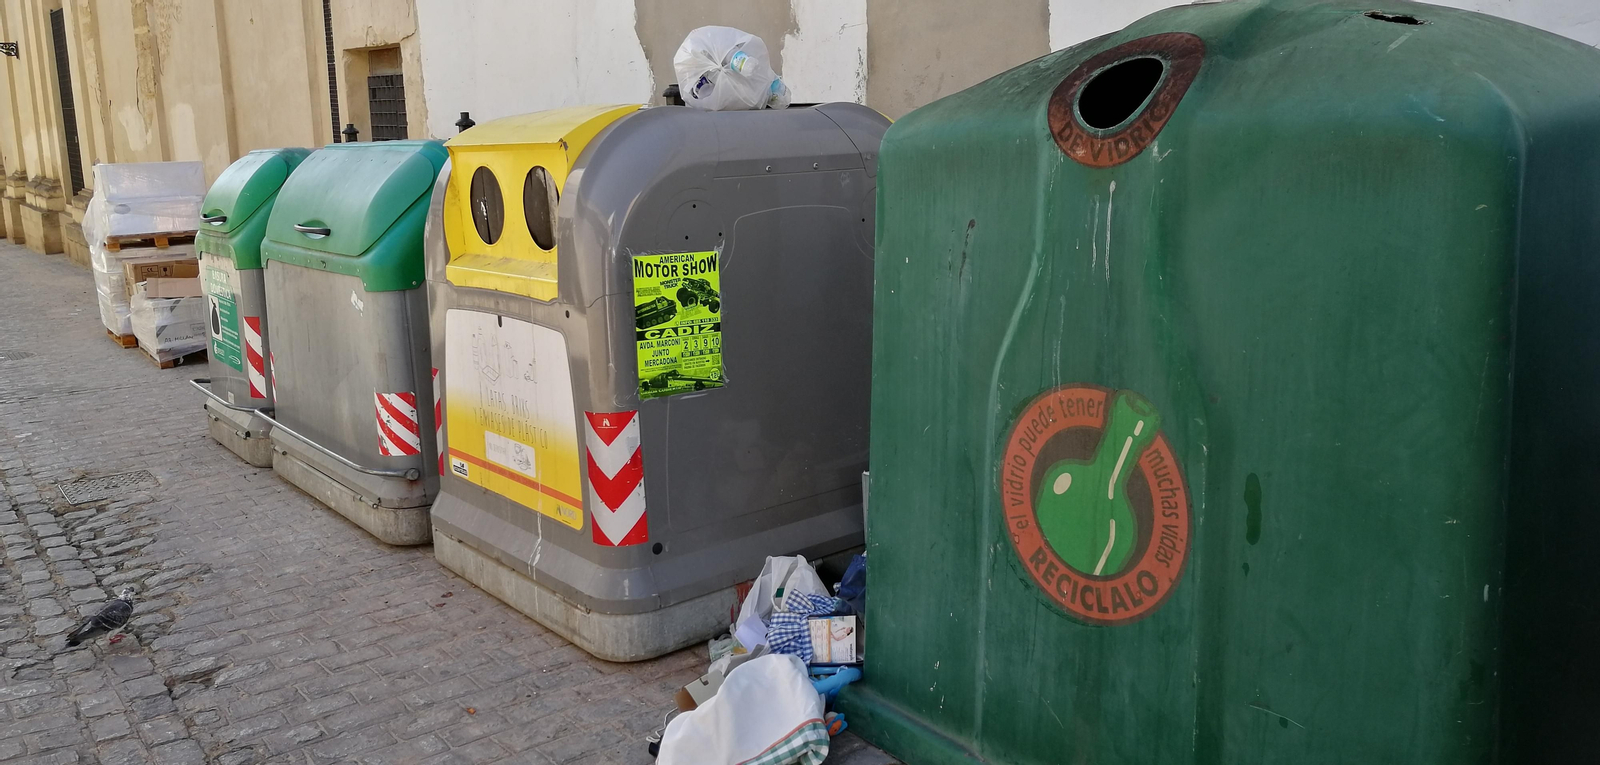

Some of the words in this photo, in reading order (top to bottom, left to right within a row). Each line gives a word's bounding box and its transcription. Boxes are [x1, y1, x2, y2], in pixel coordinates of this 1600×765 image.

[1057, 120, 1084, 155] DE
[1089, 104, 1170, 162] VIDRIO
[634, 258, 678, 278] MOTOR
[682, 253, 717, 276] SHOW
[659, 254, 694, 264] AMERICAN
[644, 323, 715, 340] CADIZ
[640, 341, 655, 350] AVDA.
[656, 338, 680, 348] MARCONI
[652, 348, 669, 358] JUNTO
[684, 341, 689, 350] 2
[694, 340, 698, 348] 3
[703, 338, 708, 347] 9
[712, 337, 719, 346] 10
[644, 356, 678, 367] MERCADONA
[1059, 396, 1103, 419] tener
[1019, 404, 1057, 458] puede
[1005, 452, 1027, 507] vidrio
[1145, 448, 1181, 520] muchas
[1009, 514, 1029, 530] el
[1154, 523, 1183, 569] vidas
[1029, 545, 1159, 615] RECICLALO
